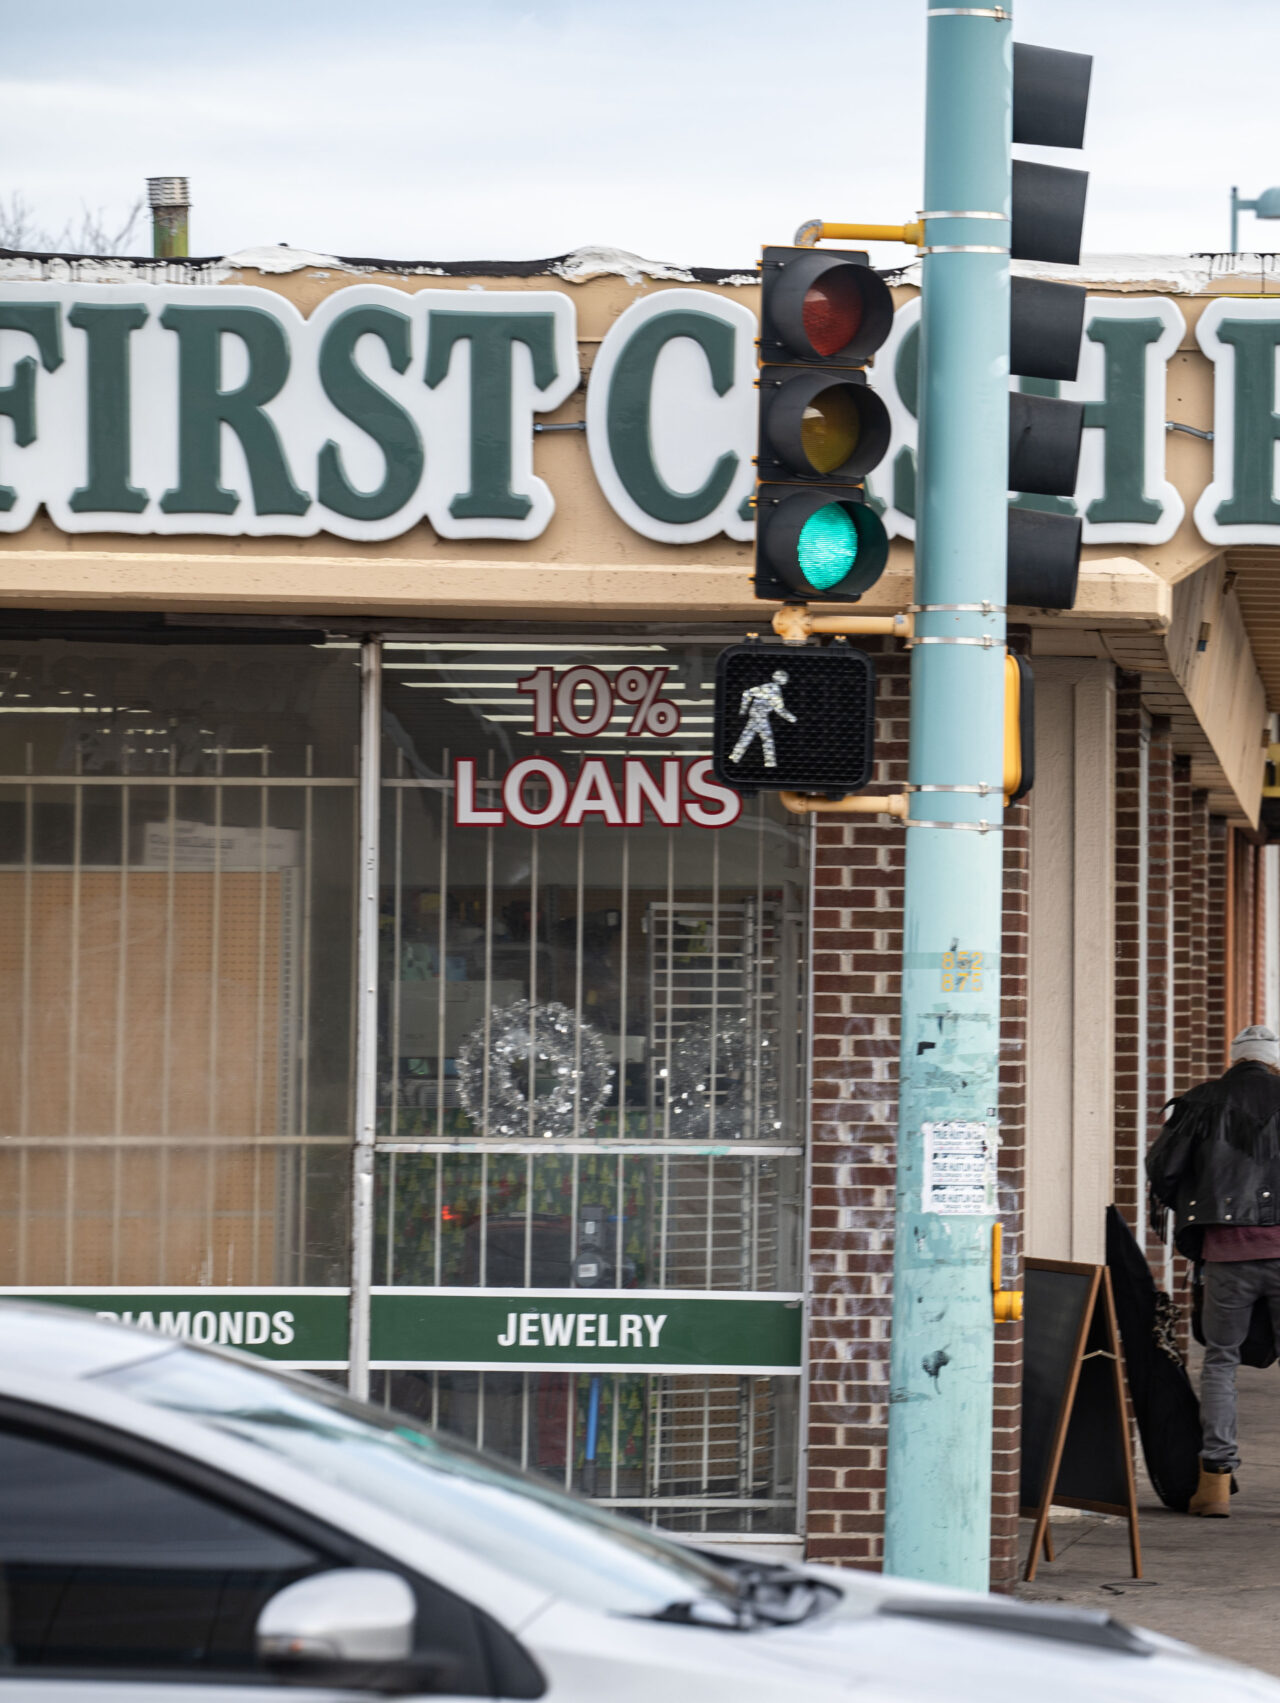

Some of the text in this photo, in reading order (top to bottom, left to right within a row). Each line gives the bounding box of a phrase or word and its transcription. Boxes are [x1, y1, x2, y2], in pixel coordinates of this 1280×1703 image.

[606, 308, 1165, 524] CH
[517, 665, 681, 737] 10%
[455, 755, 743, 829] LOANS
[941, 951, 984, 969] 852
[941, 973, 984, 992] 875
[96, 1311, 295, 1345] AMONDS
[497, 1312, 668, 1347] JEWELRY
